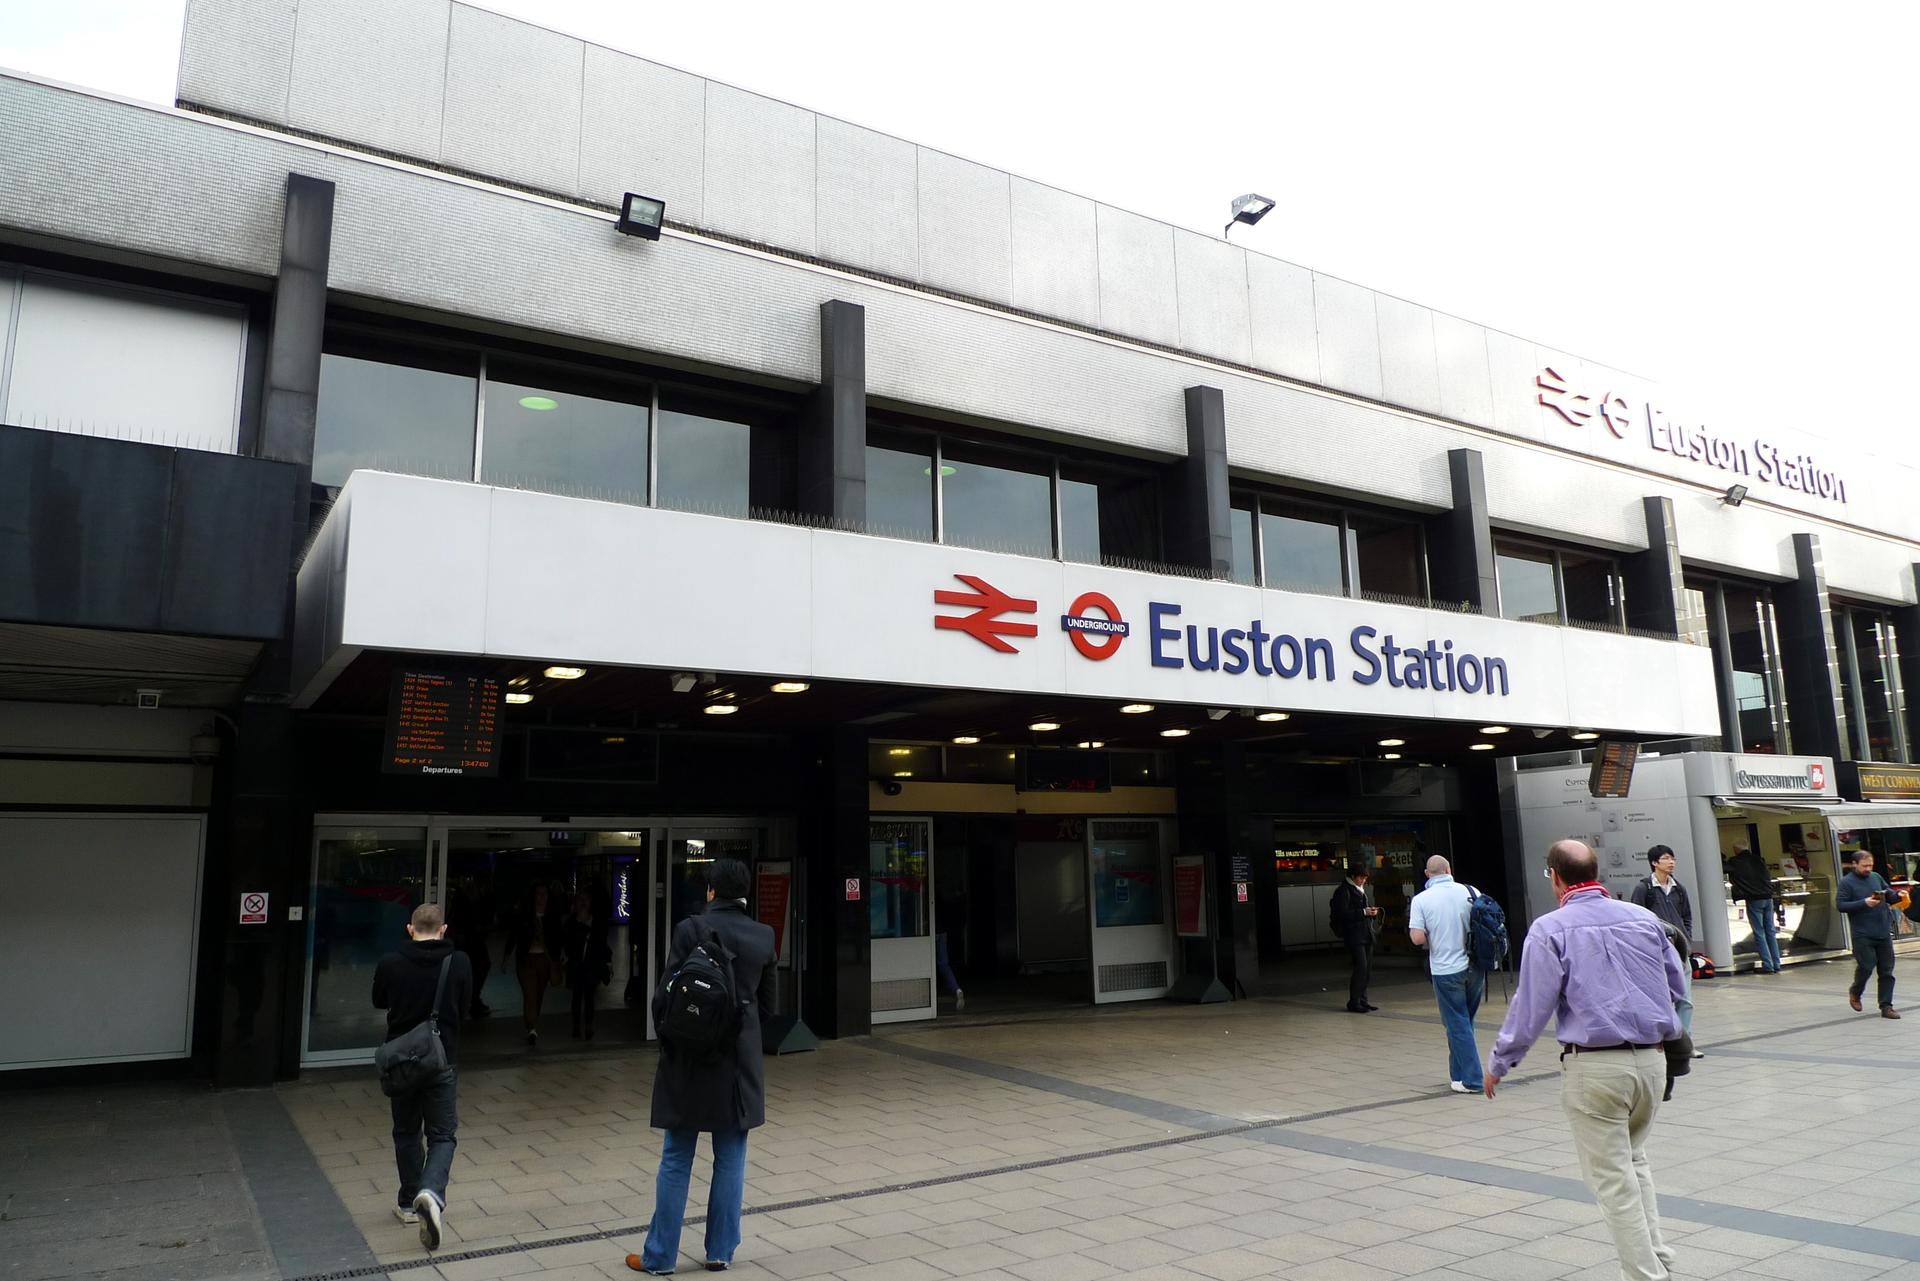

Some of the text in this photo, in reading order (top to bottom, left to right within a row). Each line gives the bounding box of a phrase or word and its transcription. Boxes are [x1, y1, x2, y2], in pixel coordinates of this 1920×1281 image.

[1646, 402, 1848, 504] Euston Station
[1067, 618, 1126, 633] UNDERGROUND
[1148, 600, 1510, 697] Euston Station
[422, 765, 463, 775] Departures
[1862, 773, 1887, 788] WEST
[686, 1003, 700, 1017] EA
